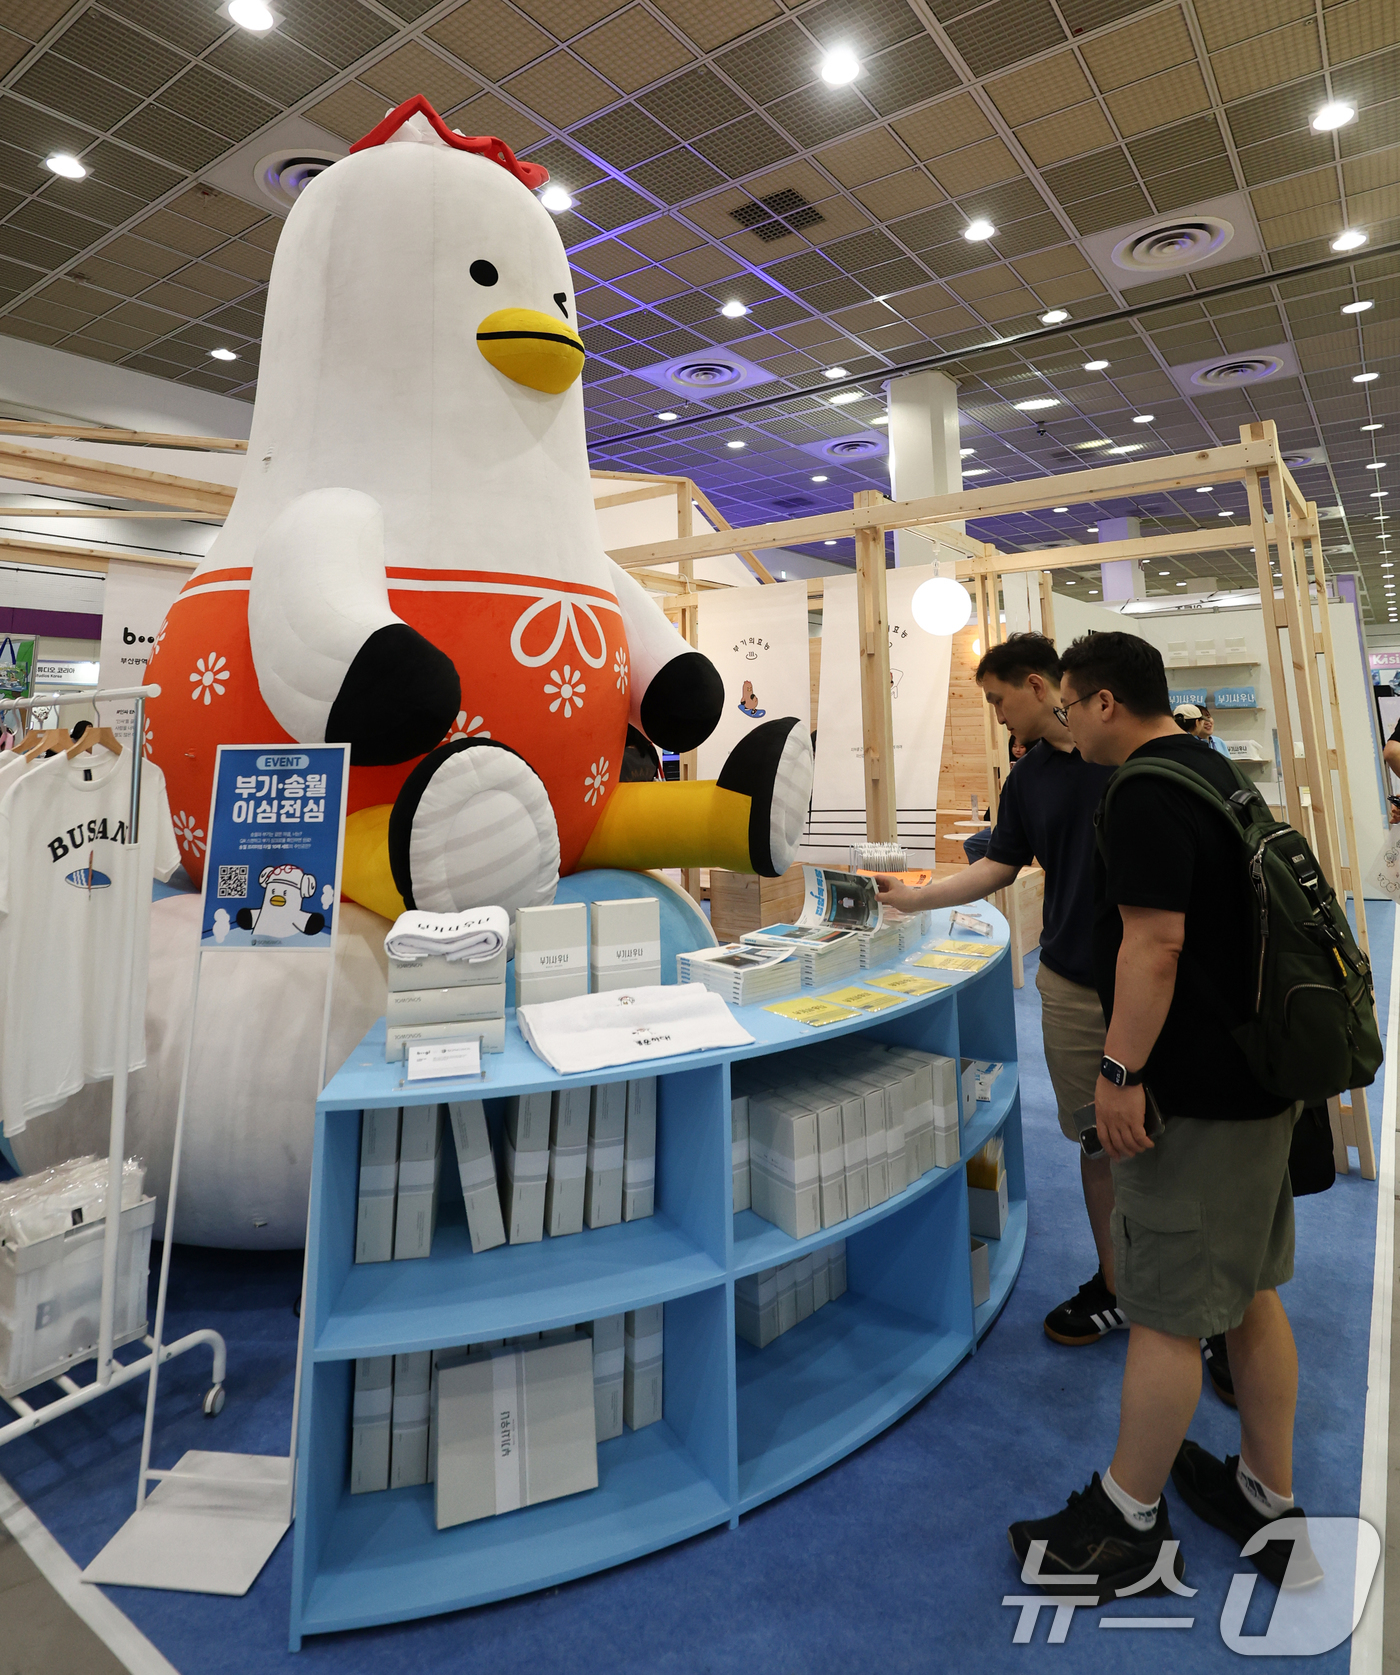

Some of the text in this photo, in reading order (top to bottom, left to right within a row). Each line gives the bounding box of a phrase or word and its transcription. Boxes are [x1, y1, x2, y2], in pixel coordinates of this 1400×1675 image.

[1218, 692, 1255, 703] 부기사우나
[264, 756, 302, 768] EVENT
[234, 773, 328, 799] 부기·송월
[231, 798, 326, 824] 이심전심
[47, 817, 129, 864] BUSAN
[539, 953, 570, 966] 부기사우나
[615, 947, 644, 960] 부기사우나
[500, 1410, 511, 1458] 부기사우나
